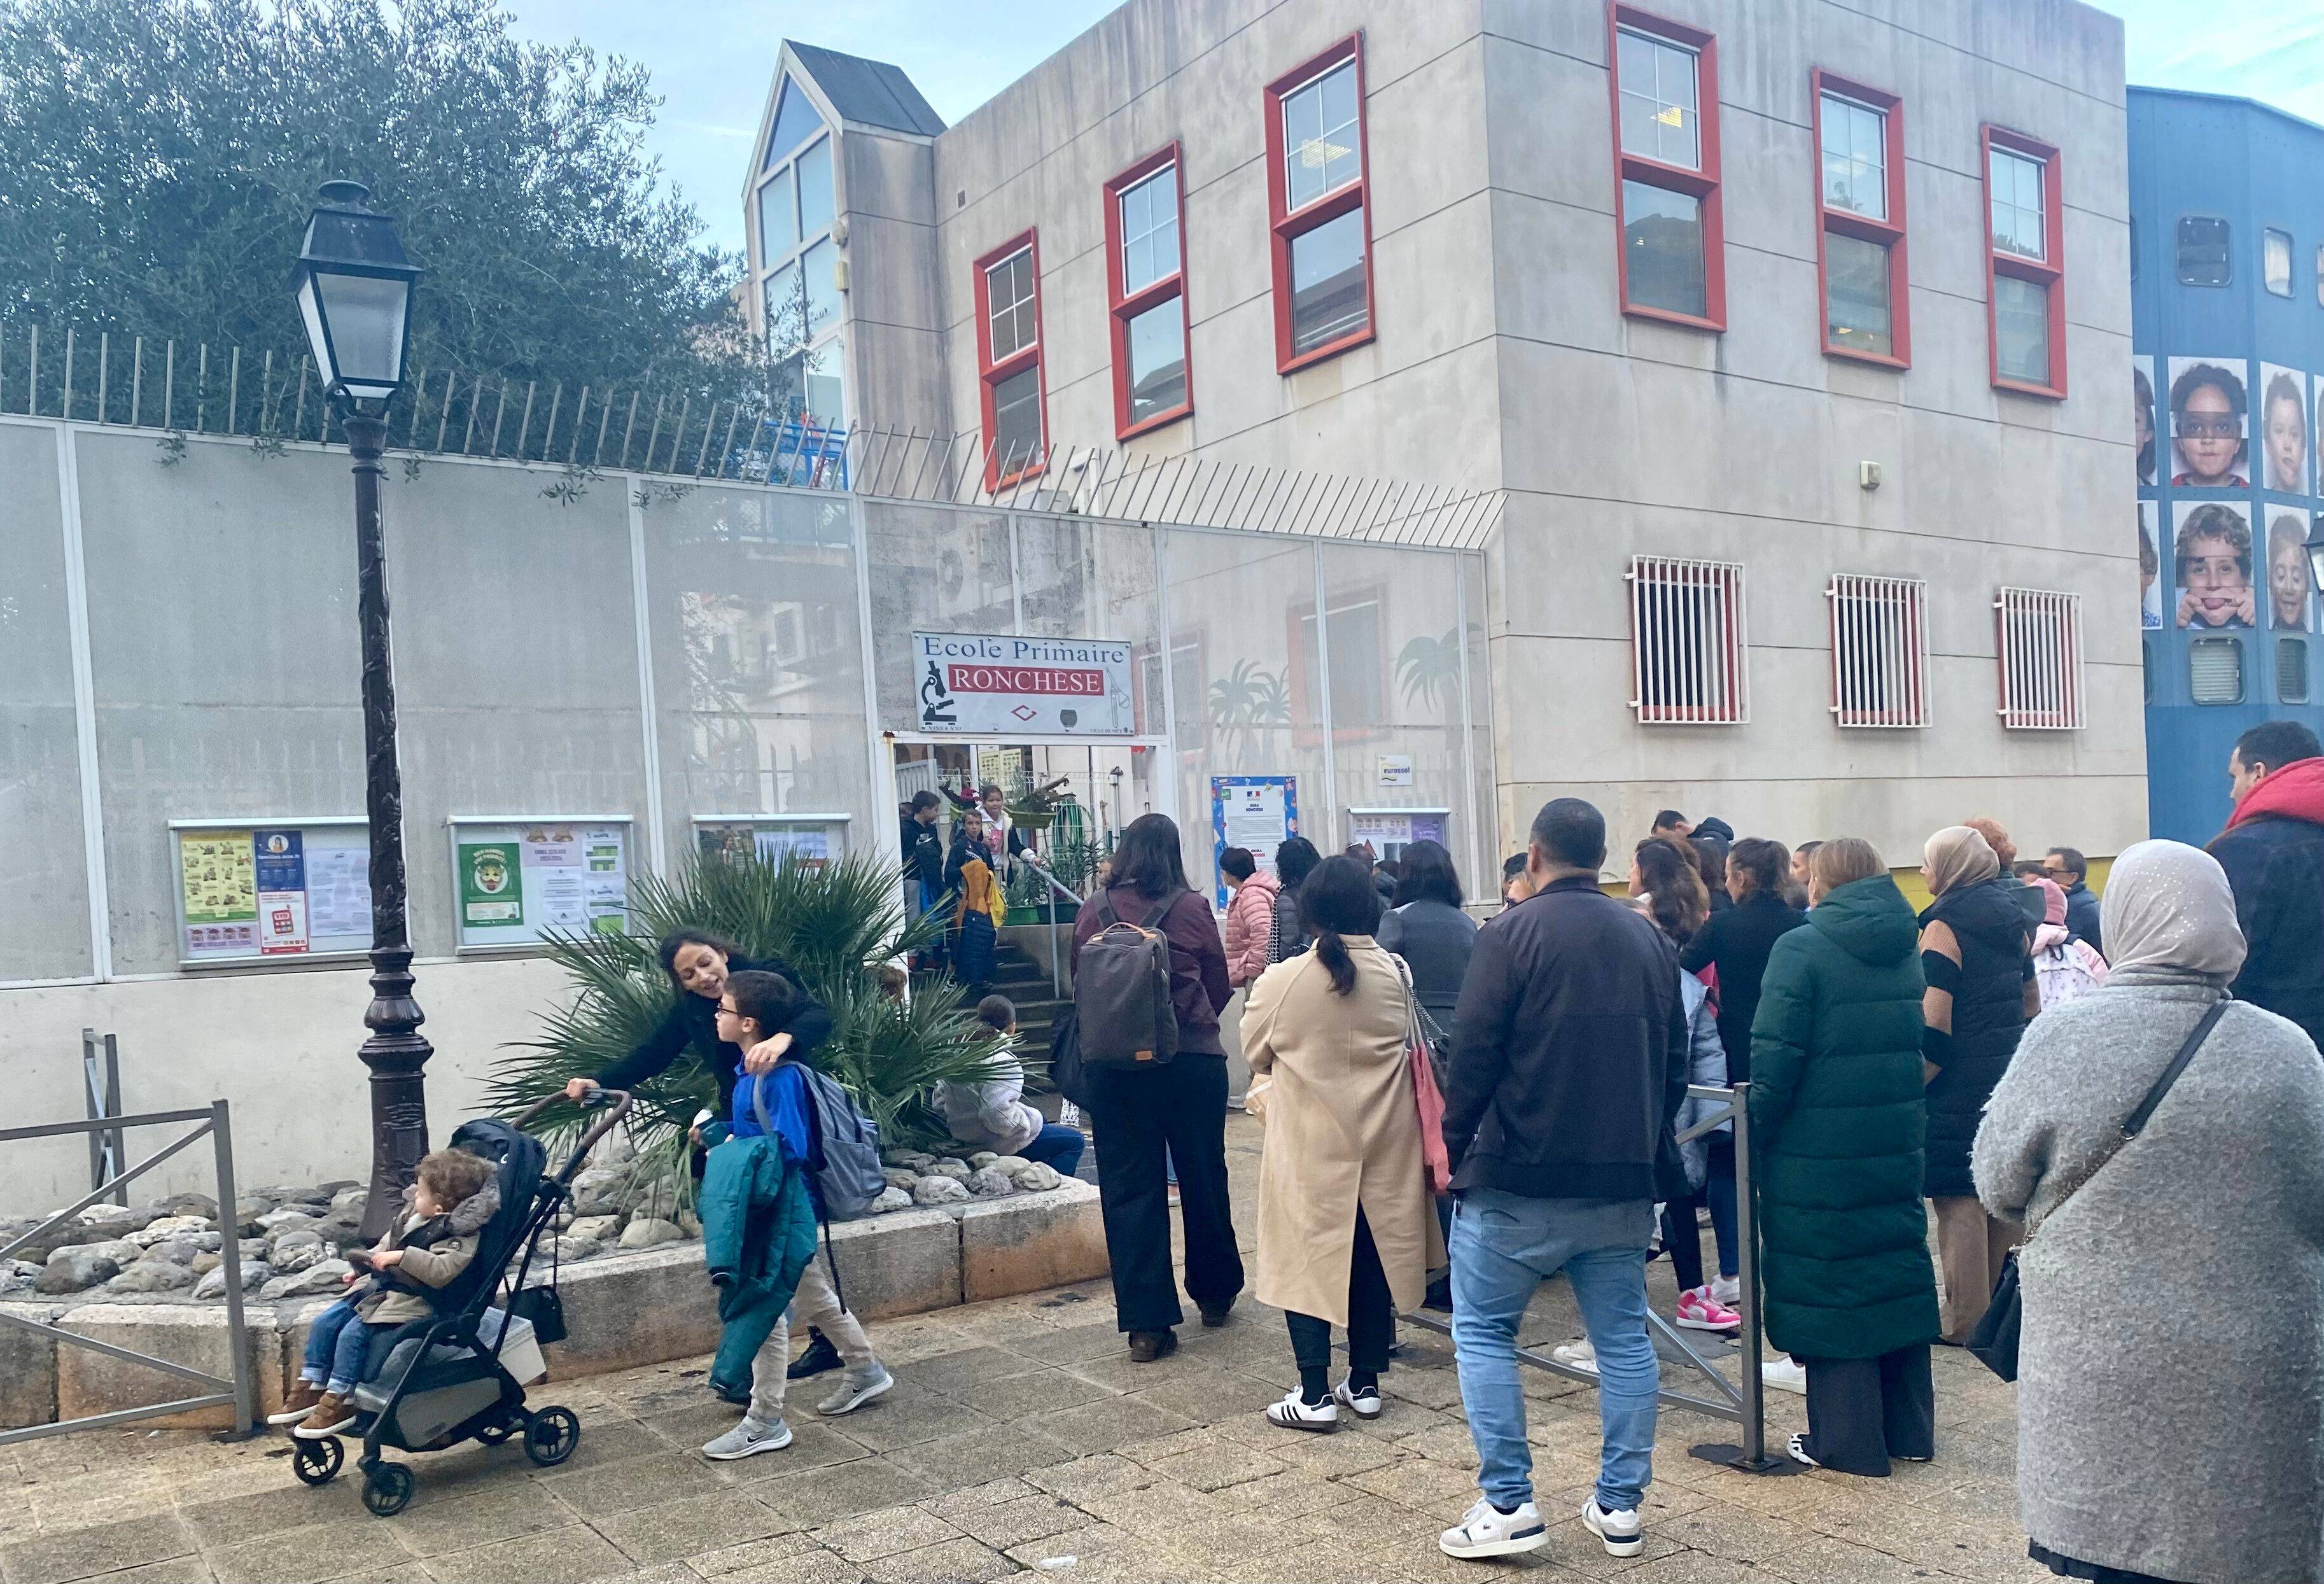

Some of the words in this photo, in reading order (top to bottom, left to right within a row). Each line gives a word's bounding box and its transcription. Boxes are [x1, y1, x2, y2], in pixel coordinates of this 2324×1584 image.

[923, 636, 1002, 658] Ecole
[1012, 640, 1124, 664] Primaire
[952, 668, 1101, 692] RONCHÈSE
